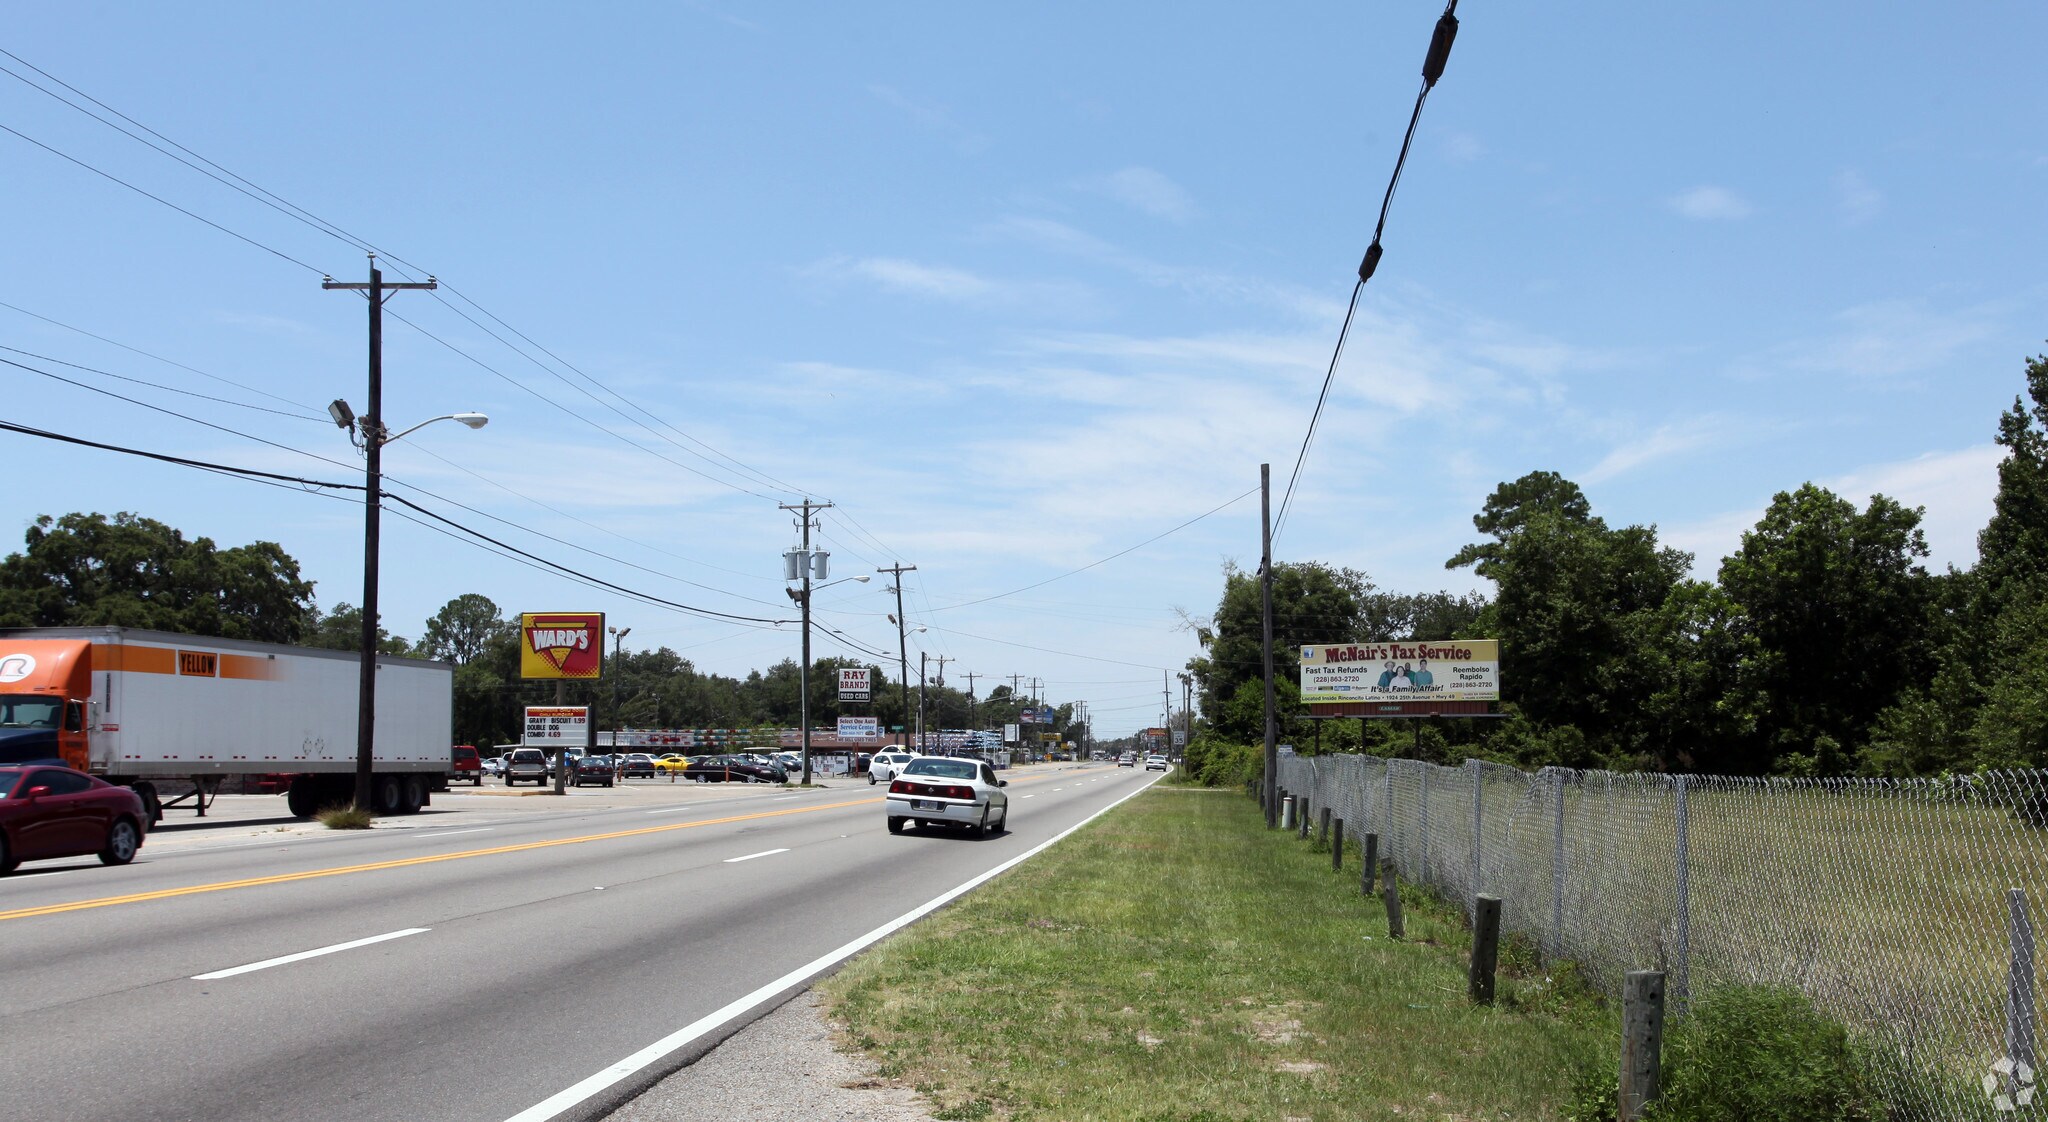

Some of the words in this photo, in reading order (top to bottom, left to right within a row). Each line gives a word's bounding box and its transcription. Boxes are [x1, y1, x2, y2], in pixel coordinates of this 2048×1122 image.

[532, 630, 588, 651] WARD'S
[1326, 646, 1387, 663] McNair's
[1390, 644, 1416, 660] Tax
[1418, 644, 1472, 660] Service
[180, 653, 215, 675] YELLOW
[1323, 666, 1335, 674] Tax
[1337, 666, 1368, 674] Refunds
[843, 671, 866, 679] RAY
[1459, 673, 1483, 681] Rapido
[1371, 685, 1382, 693] It's
[1392, 684, 1417, 693] Family
[1418, 684, 1444, 692] Affair!
